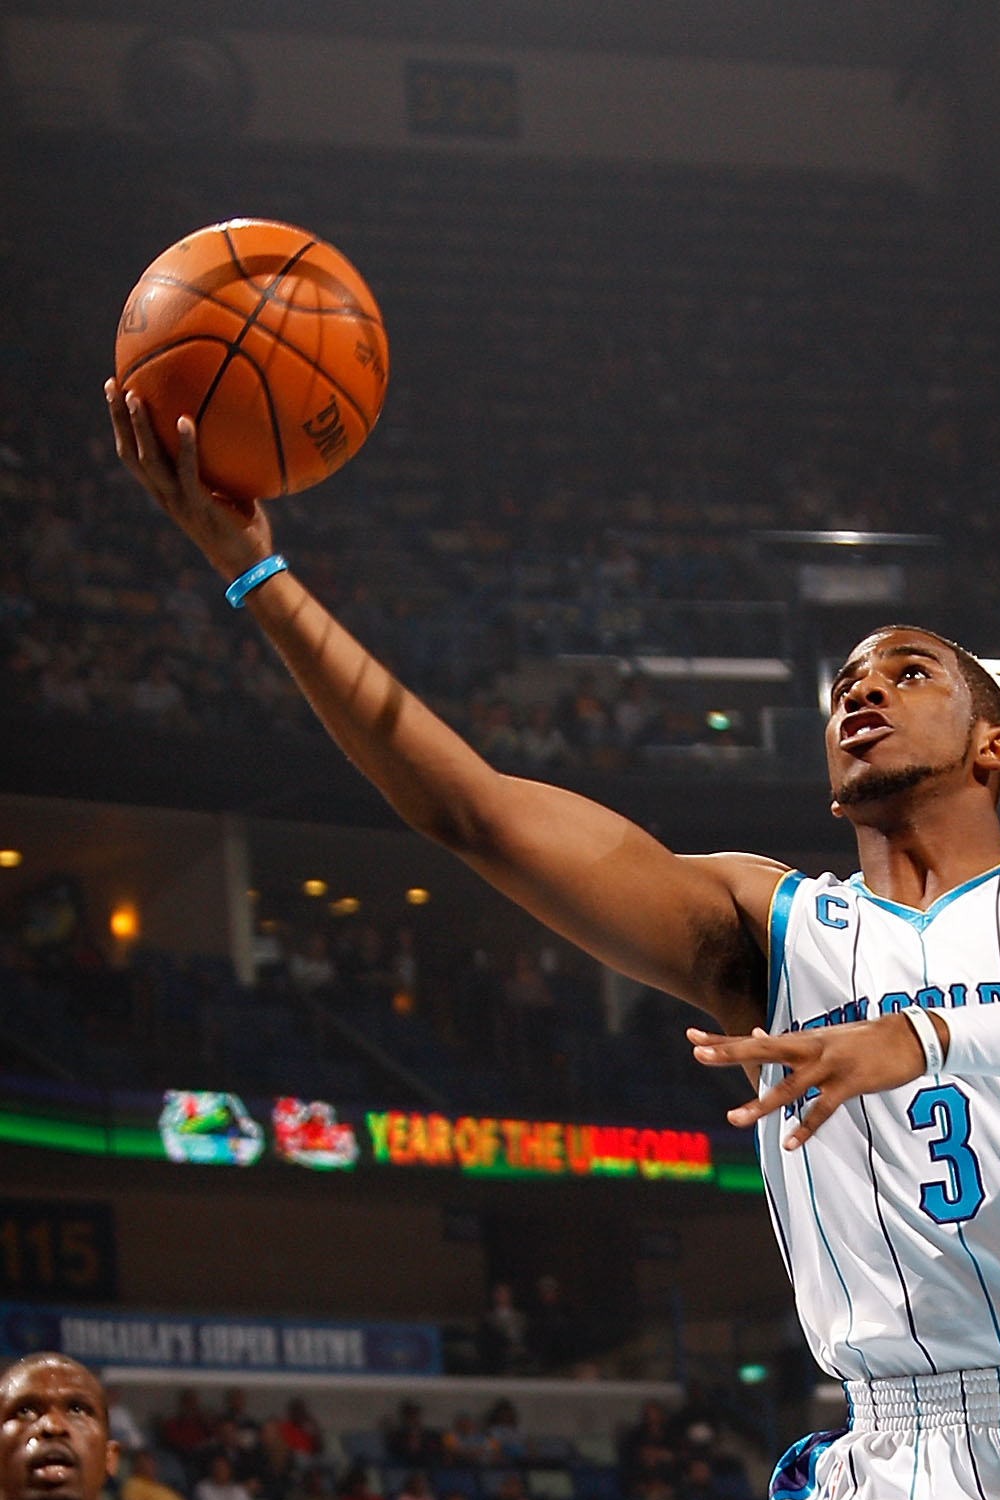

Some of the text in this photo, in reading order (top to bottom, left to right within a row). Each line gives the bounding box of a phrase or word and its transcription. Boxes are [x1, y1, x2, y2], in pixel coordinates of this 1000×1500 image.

[815, 893, 849, 930] C
[365, 1109, 711, 1180] YEAR OF THE UNIFORM
[906, 1083, 986, 1225] 3
[0, 1217, 100, 1288] 115
